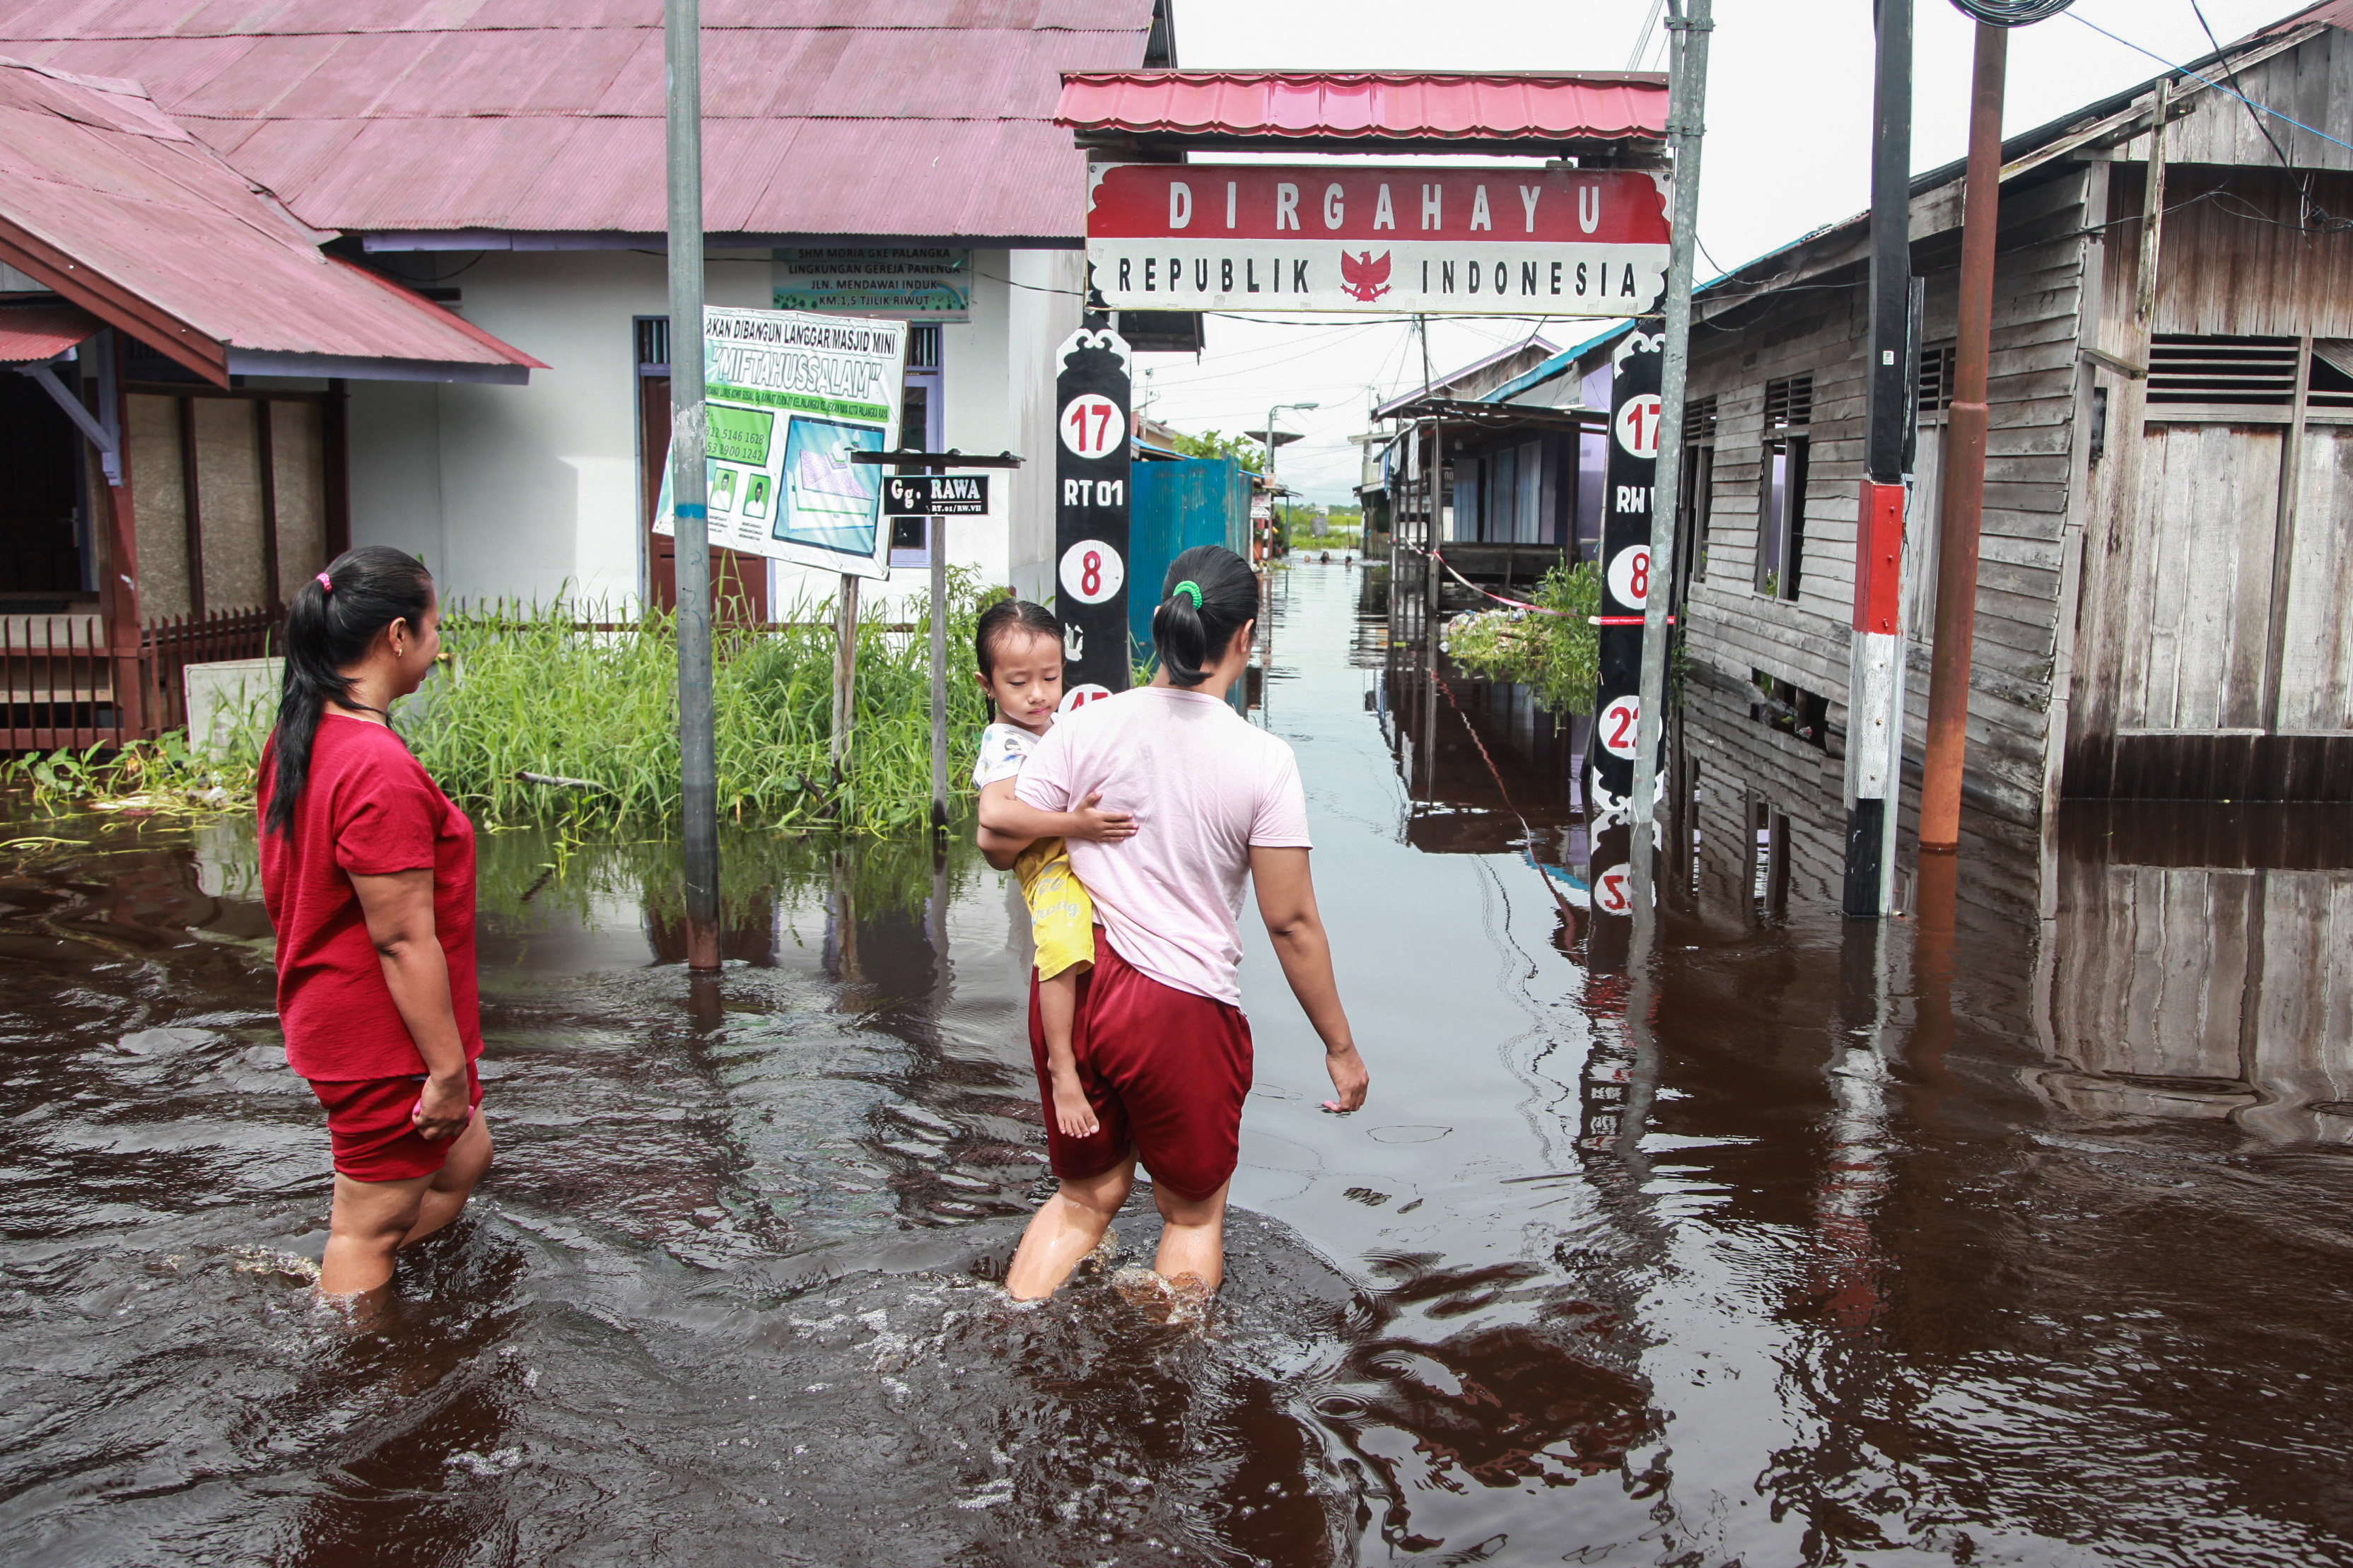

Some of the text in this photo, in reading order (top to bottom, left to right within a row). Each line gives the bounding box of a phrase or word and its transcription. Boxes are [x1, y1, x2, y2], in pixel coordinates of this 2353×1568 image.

[1169, 182, 1601, 234] DIRGAHAYU
[798, 248, 951, 259] SHM MORIA GKE PALANGKA
[788, 264, 961, 275] LINGKUNGAN GEREJA PANENGA
[1118, 257, 1637, 298] REPUBLIK INDONESIA
[811, 279, 938, 291] JLN. MENDAWAI INDUK
[860, 296, 890, 305] TJILIK
[893, 296, 930, 305] RIWUT
[706, 317, 732, 338] AKAN
[733, 320, 782, 343] DIBANGUN
[872, 332, 897, 355] MINI
[721, 428, 743, 442] 5146
[745, 432, 764, 445] 1628
[1070, 404, 1111, 452] 17
[720, 444, 740, 457] 8900
[742, 447, 762, 461] 1242
[891, 479, 981, 509] Gg. RAWA
[1064, 479, 1123, 507] RT 01
[1616, 485, 1645, 514] RW
[1081, 550, 1101, 596] 8
[1630, 551, 1650, 599] 8
[1608, 706, 1638, 749] 2
